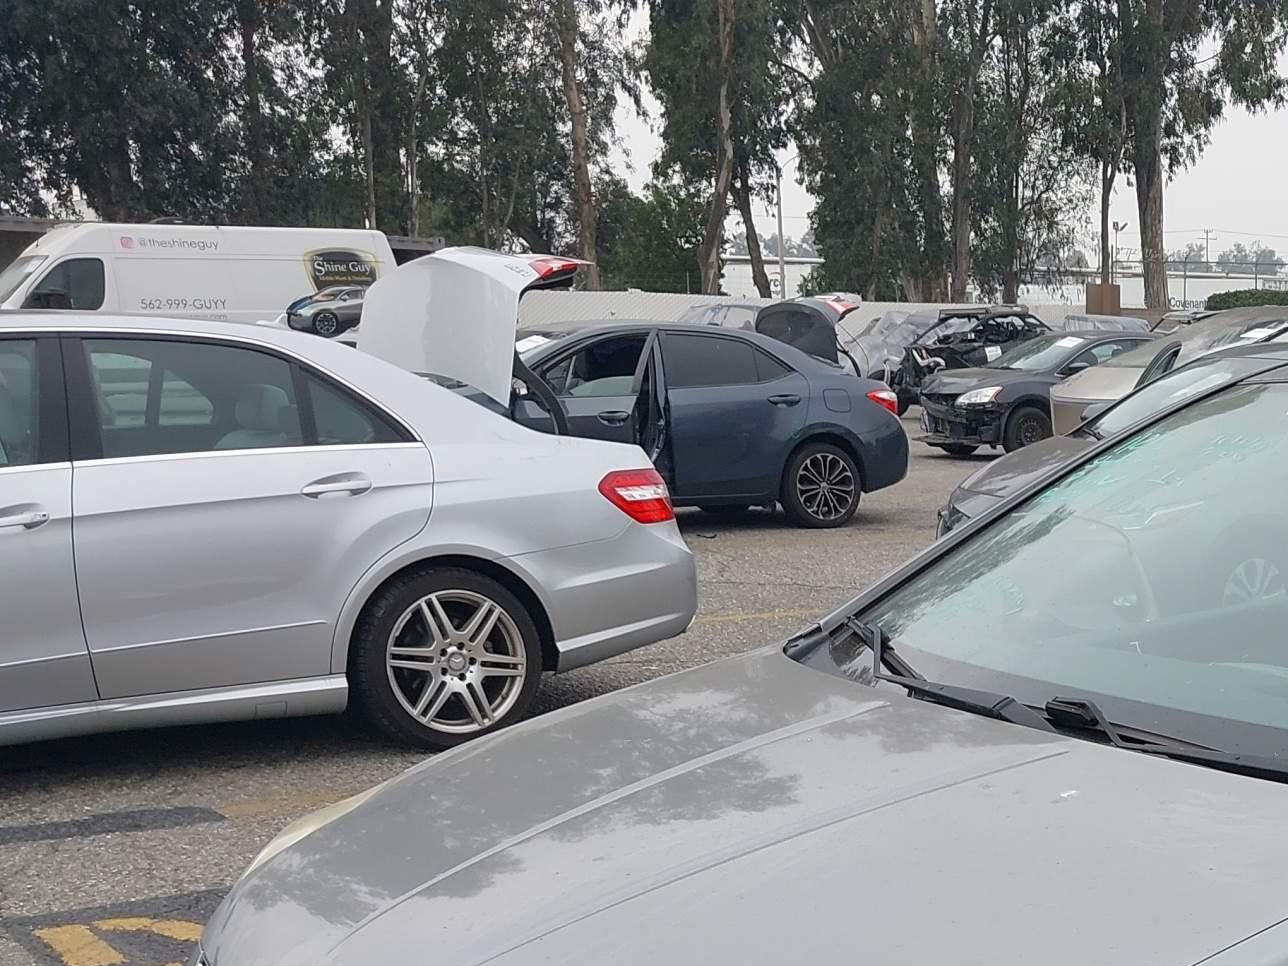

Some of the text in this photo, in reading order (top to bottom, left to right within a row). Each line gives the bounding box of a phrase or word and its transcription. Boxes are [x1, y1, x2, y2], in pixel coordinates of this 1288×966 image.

[138, 238, 219, 251] @theshineguy
[314, 260, 371, 276] Shine Guy
[140, 298, 226, 310] 562-999-GUYY
[1169, 297, 1207, 309] Covenant
